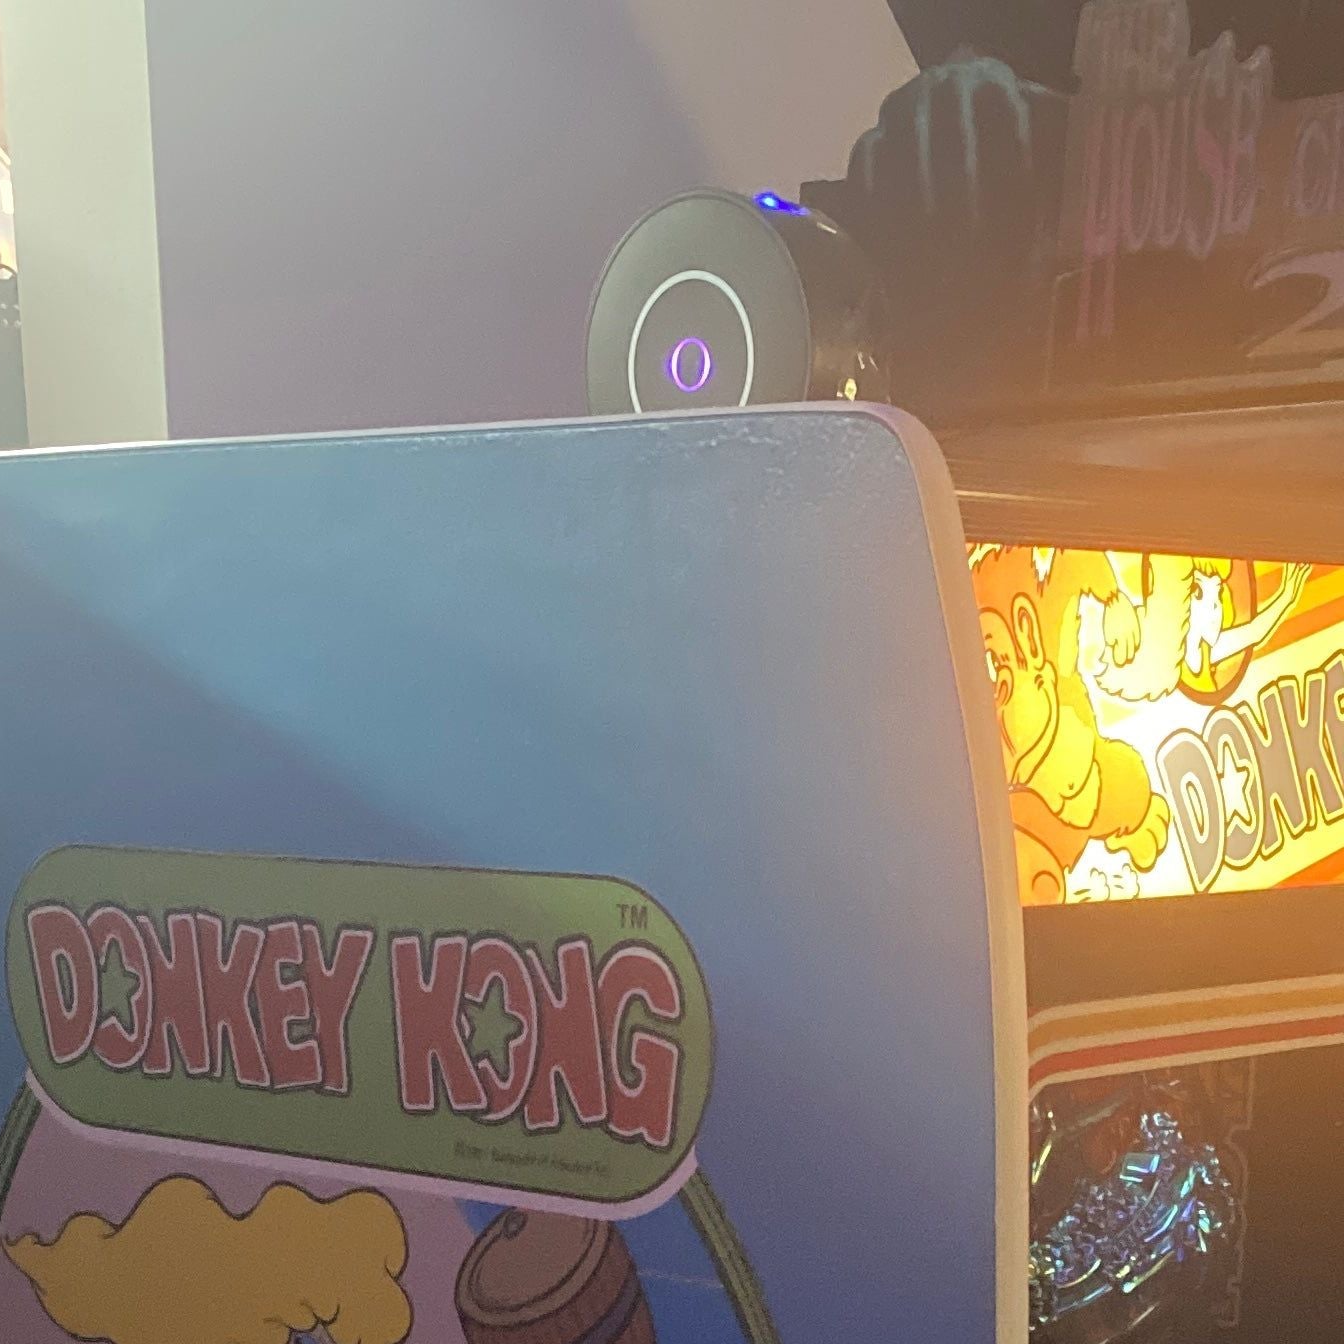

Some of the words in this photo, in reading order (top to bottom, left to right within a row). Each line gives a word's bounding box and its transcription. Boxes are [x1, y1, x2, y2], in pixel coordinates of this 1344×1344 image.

[616, 902, 649, 929] TM
[23, 900, 374, 1093] DONKEY
[387, 932, 684, 1149] KONG
